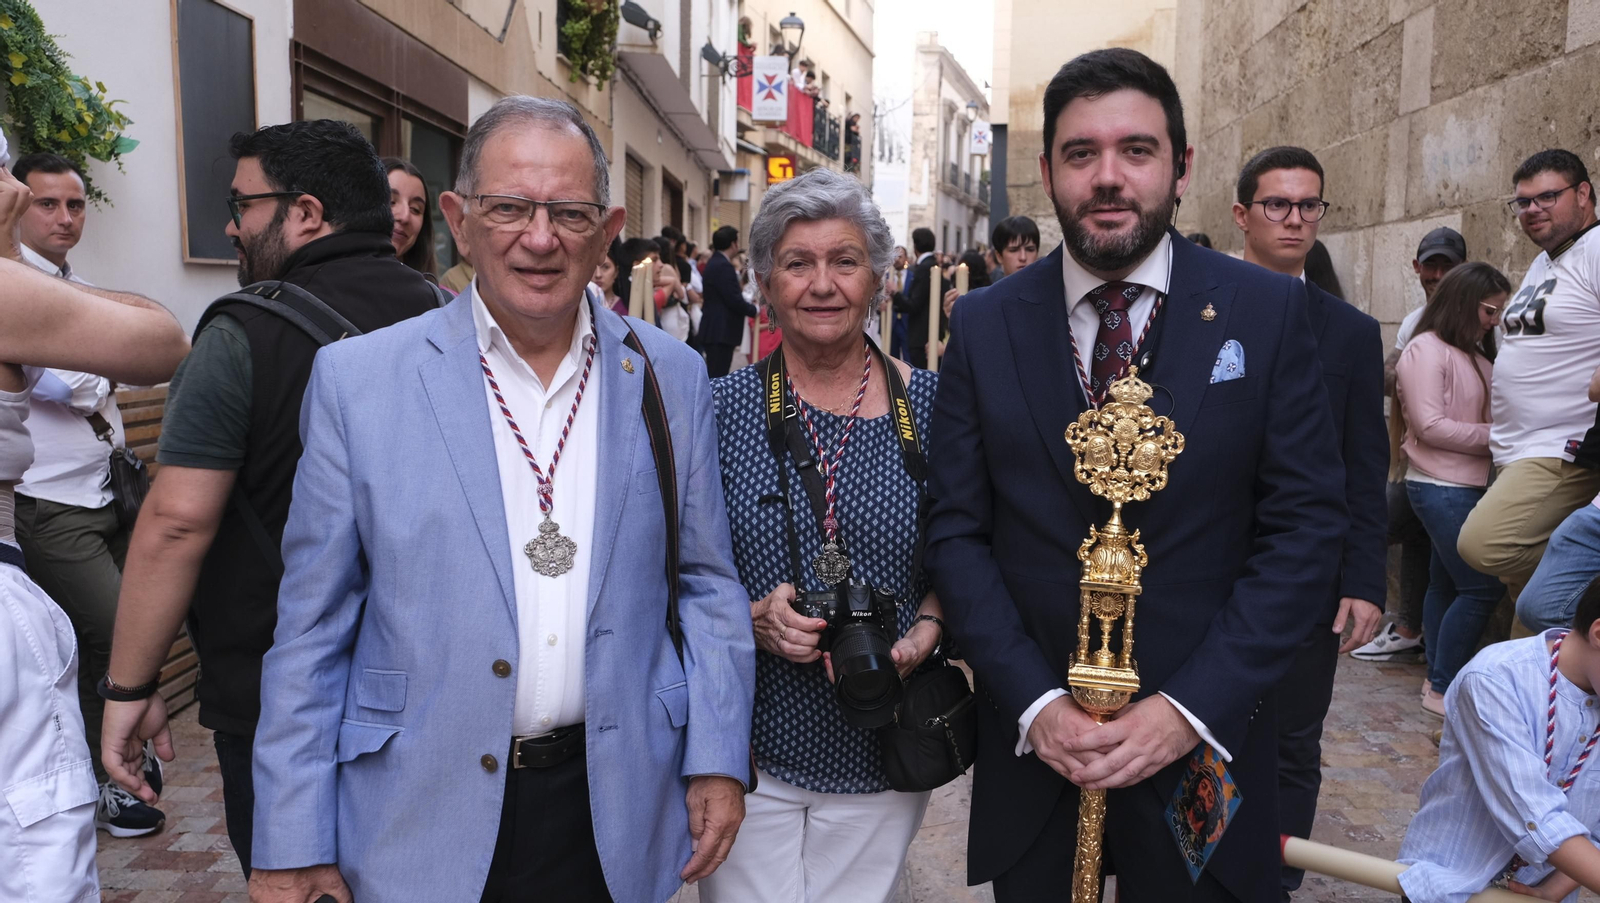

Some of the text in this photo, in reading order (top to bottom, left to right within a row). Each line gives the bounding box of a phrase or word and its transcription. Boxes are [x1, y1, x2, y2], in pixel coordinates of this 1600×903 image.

[1504, 278, 1557, 335] 26
[770, 373, 780, 413] Nikon
[896, 398, 914, 440] Nikon
[1171, 813, 1197, 865] CAUTIVO
